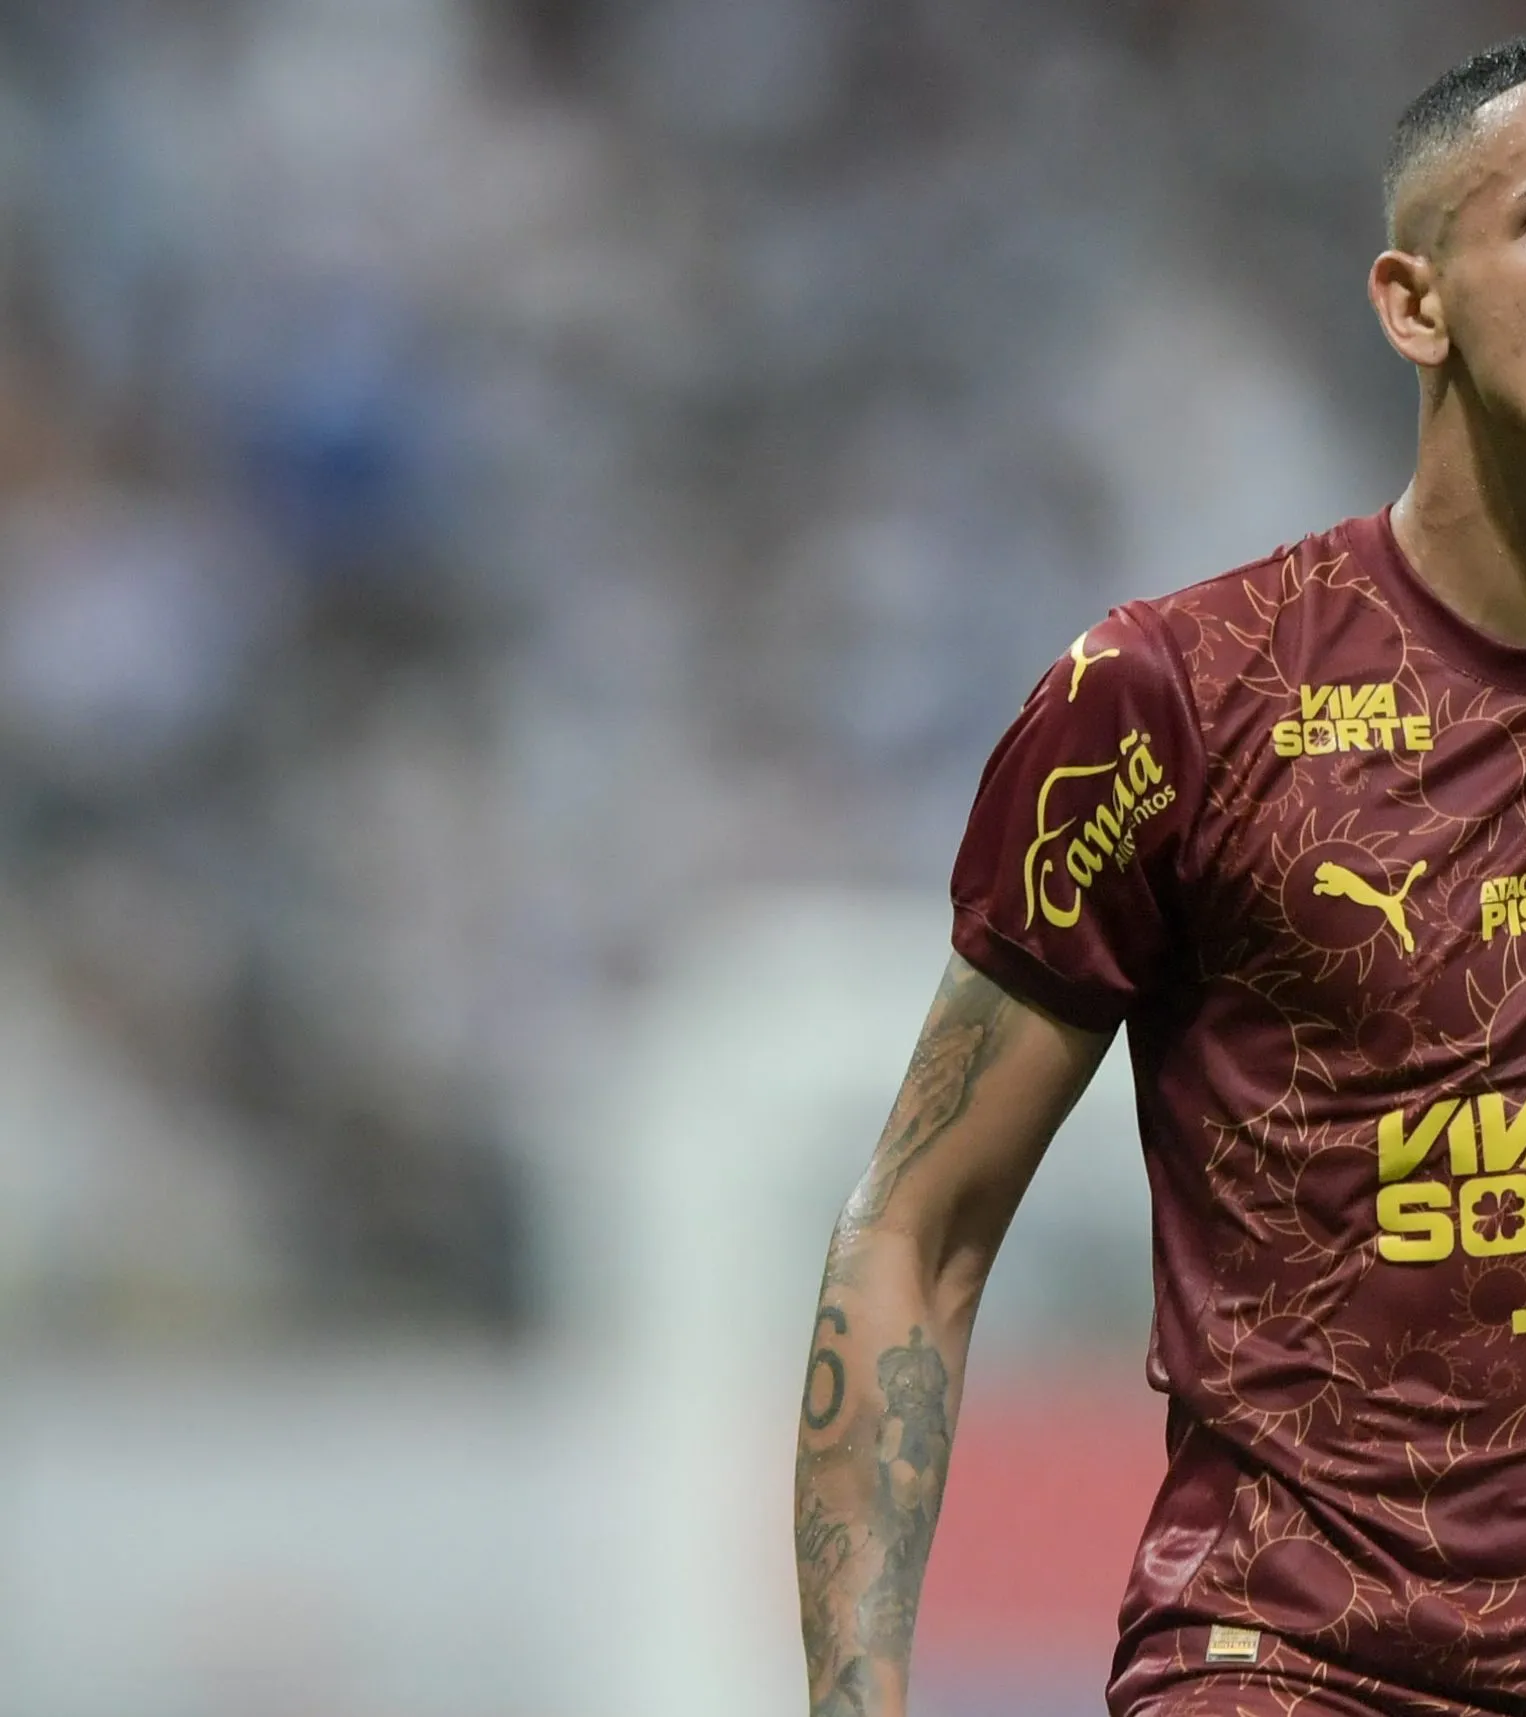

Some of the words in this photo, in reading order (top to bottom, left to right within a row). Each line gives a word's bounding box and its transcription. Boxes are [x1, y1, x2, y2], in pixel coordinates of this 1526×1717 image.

[1301, 683, 1397, 720] VIVA
[1272, 715, 1434, 757] SORTE
[1115, 783, 1177, 874] Alimntos
